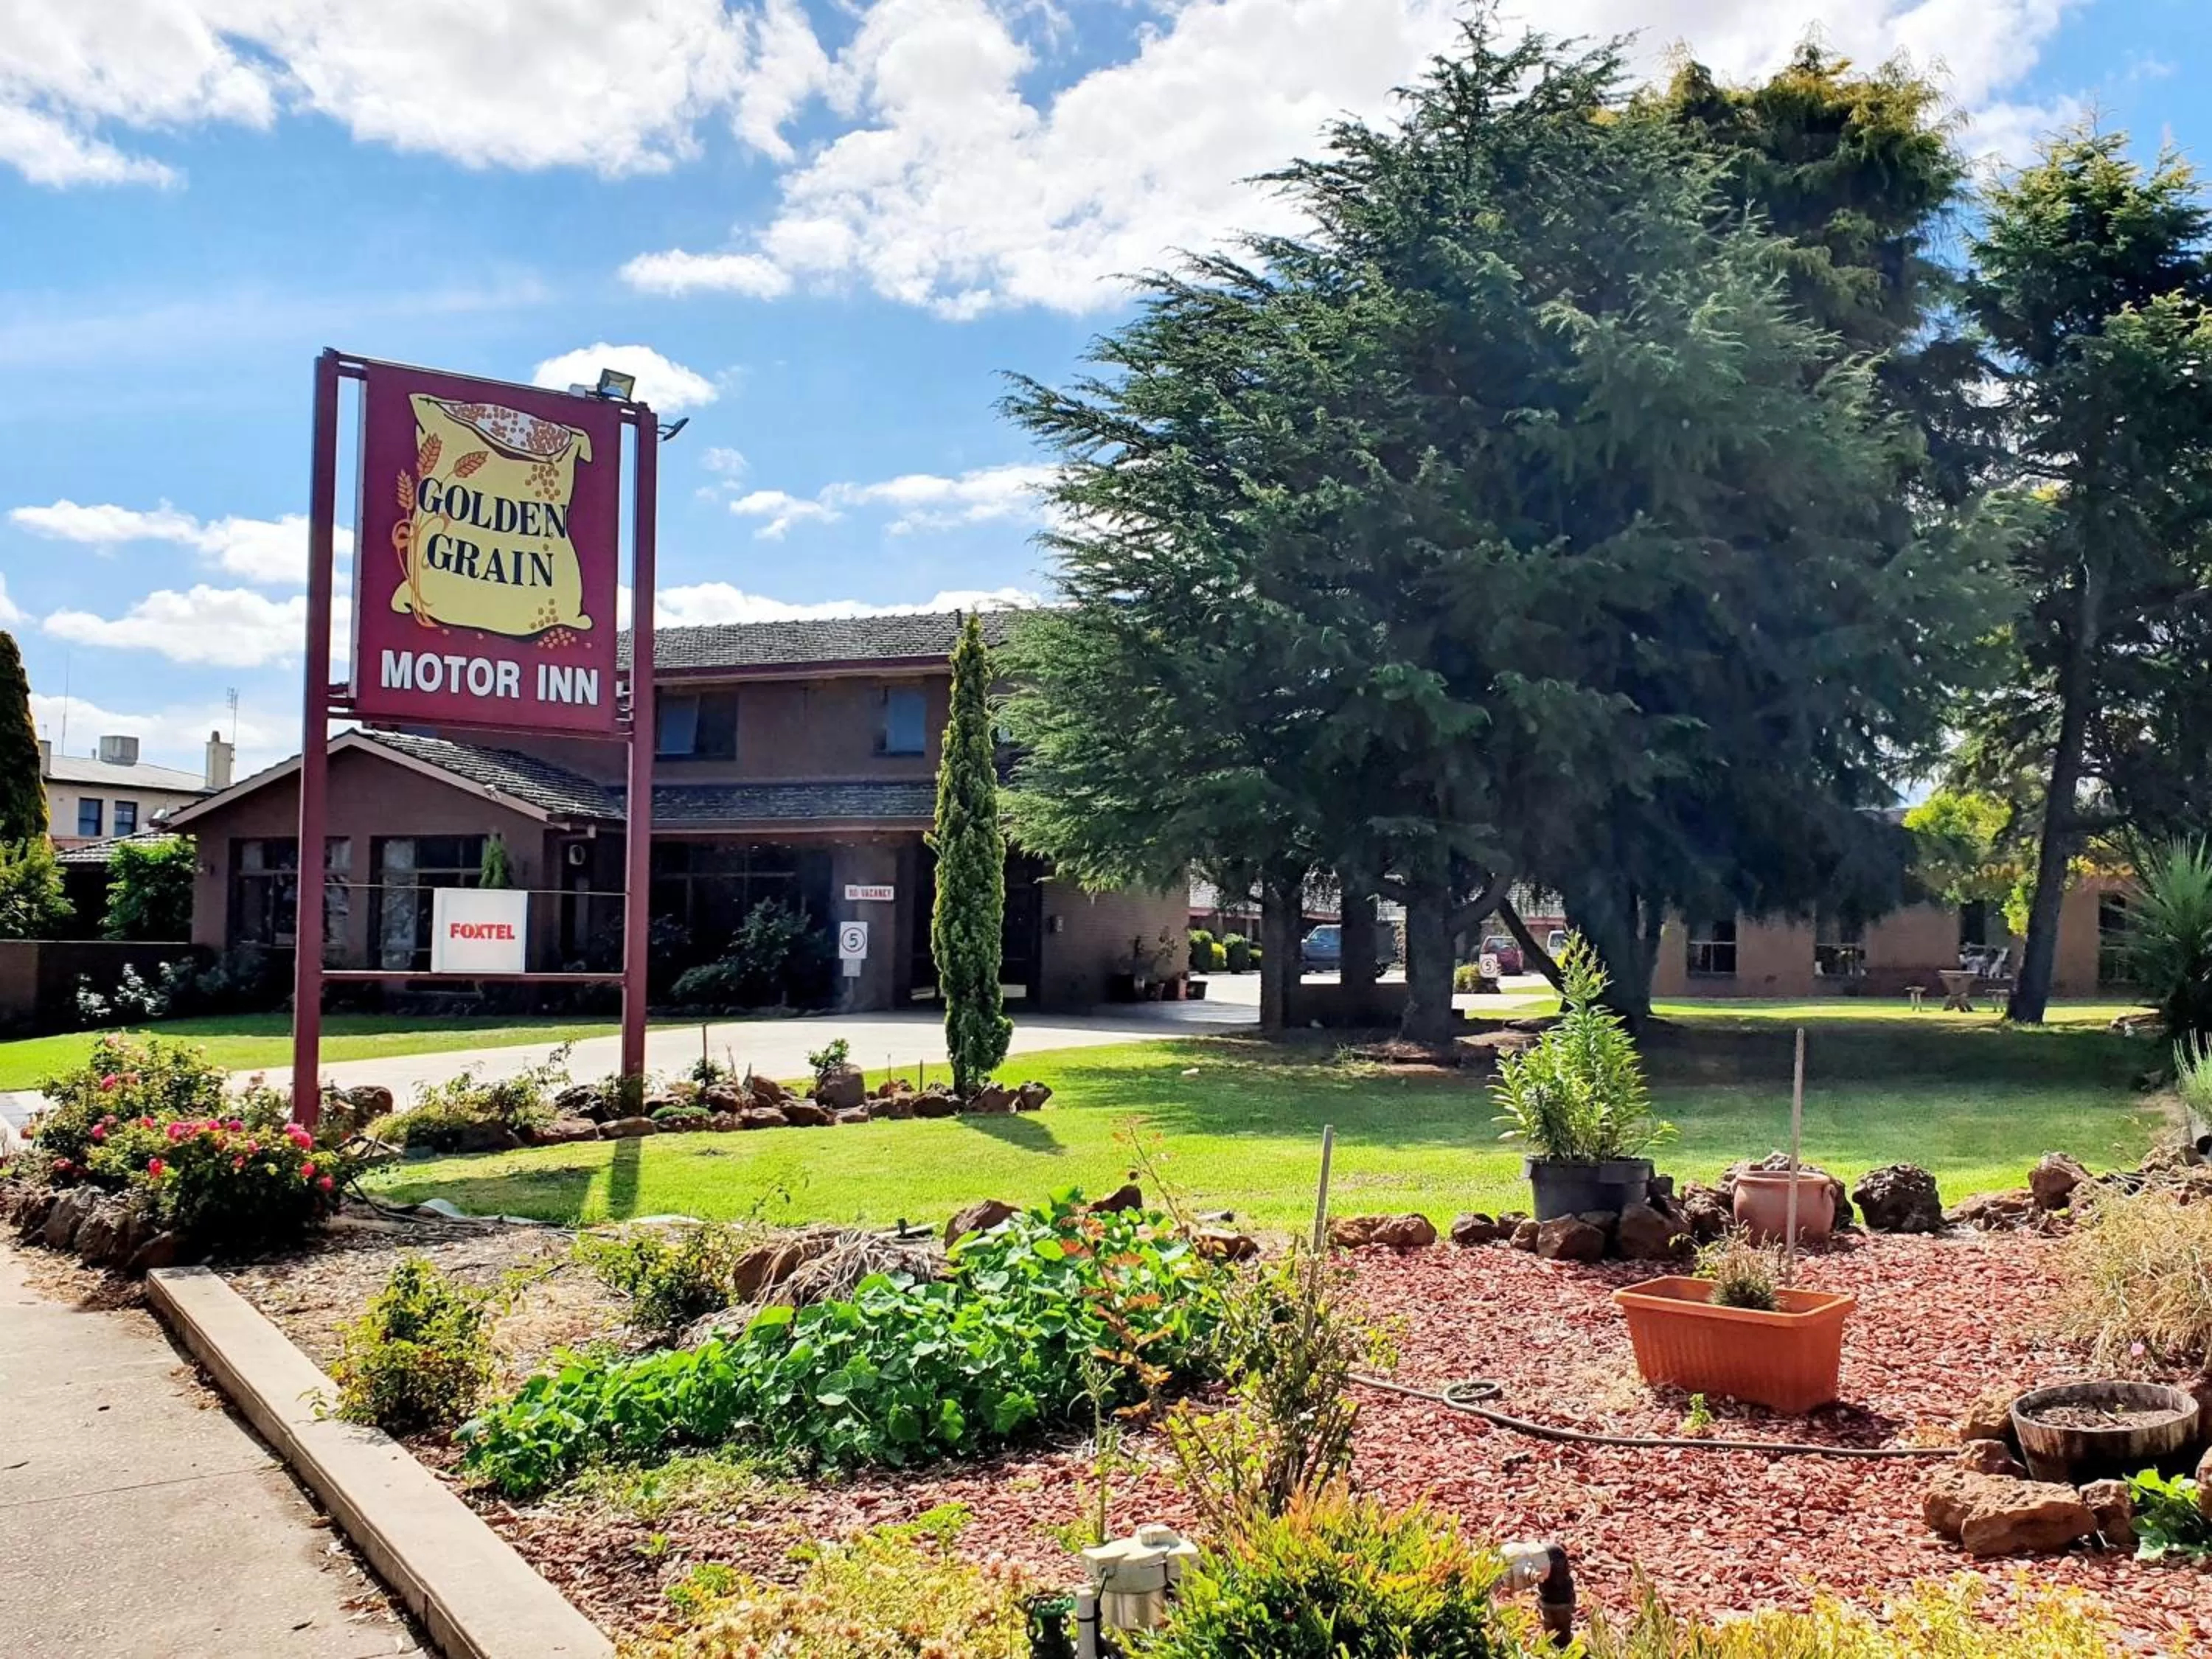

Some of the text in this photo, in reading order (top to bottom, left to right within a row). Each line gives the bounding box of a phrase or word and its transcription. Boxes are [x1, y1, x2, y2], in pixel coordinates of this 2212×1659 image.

[418, 476, 567, 538] GOLDEN
[426, 532, 554, 587] GRAIN
[380, 649, 599, 706] MOTOR INN
[861, 888, 891, 897] VACANCY
[450, 923, 515, 940] FOXTEL
[849, 933, 858, 948] 5
